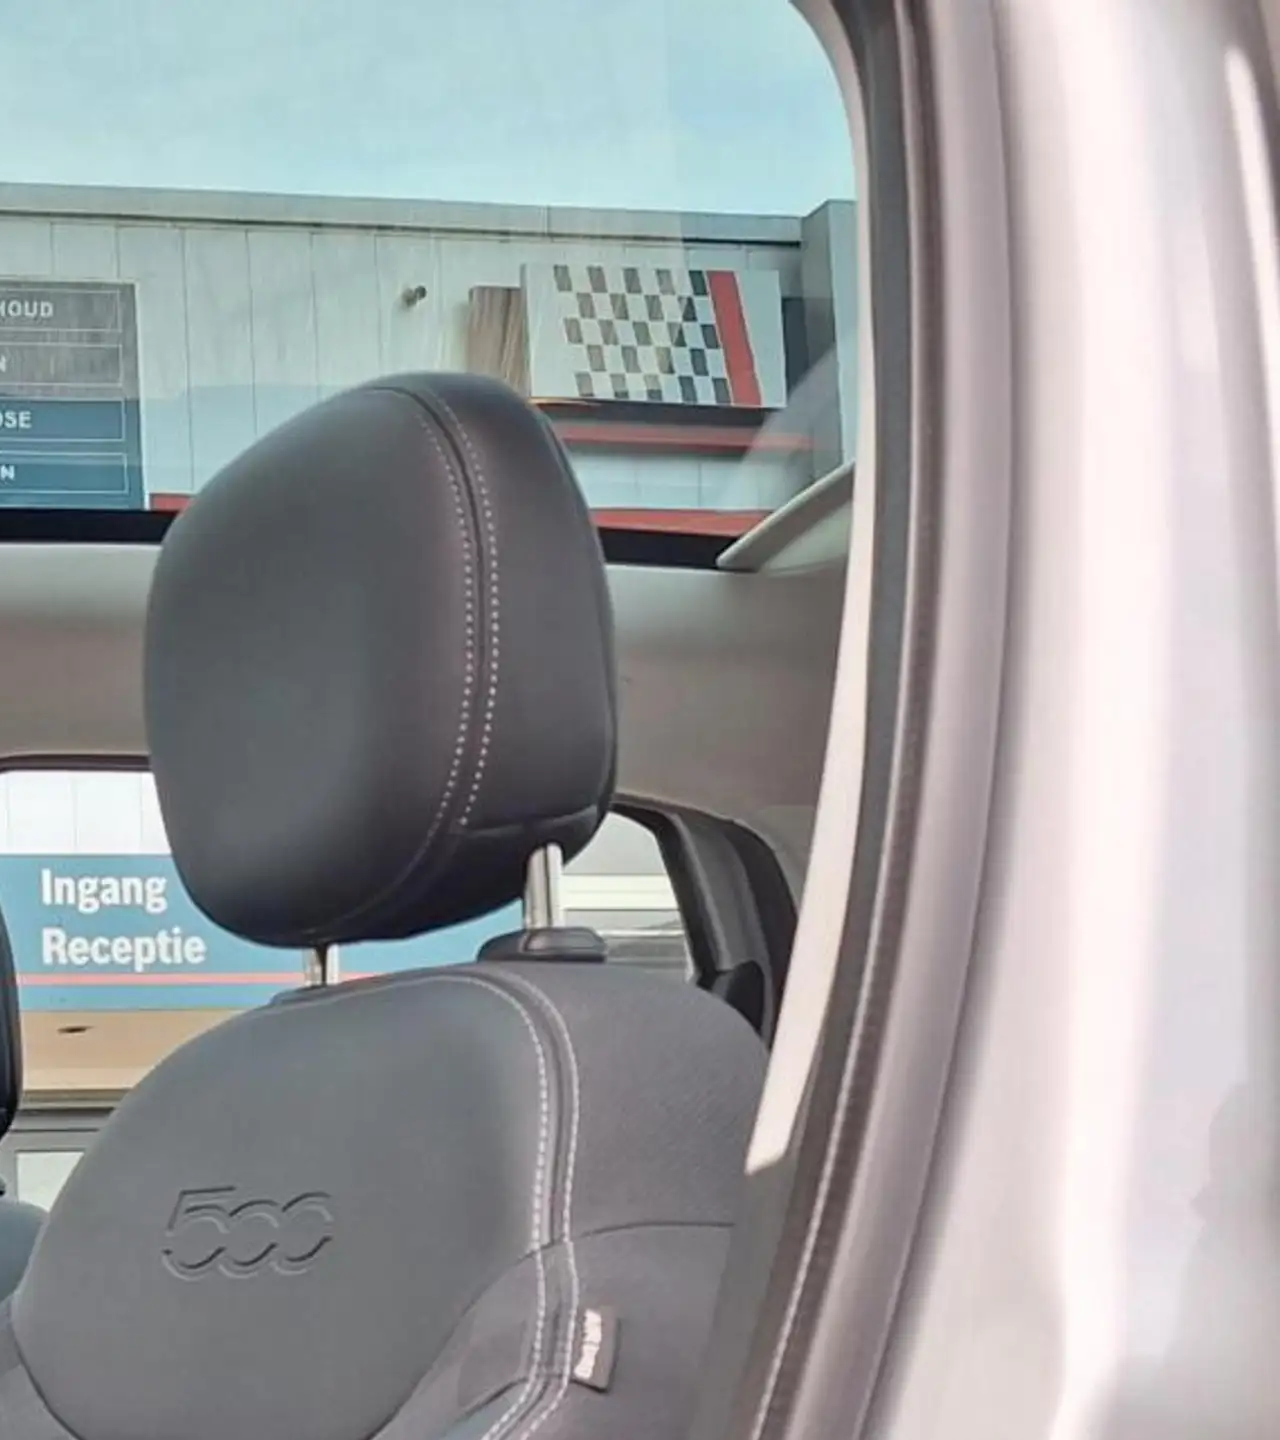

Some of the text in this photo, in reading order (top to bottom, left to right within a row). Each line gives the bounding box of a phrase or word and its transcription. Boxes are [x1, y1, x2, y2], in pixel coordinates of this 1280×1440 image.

[41, 869, 168, 913] Ingang
[41, 928, 206, 971] Receptie
[160, 1186, 335, 1281] 500
